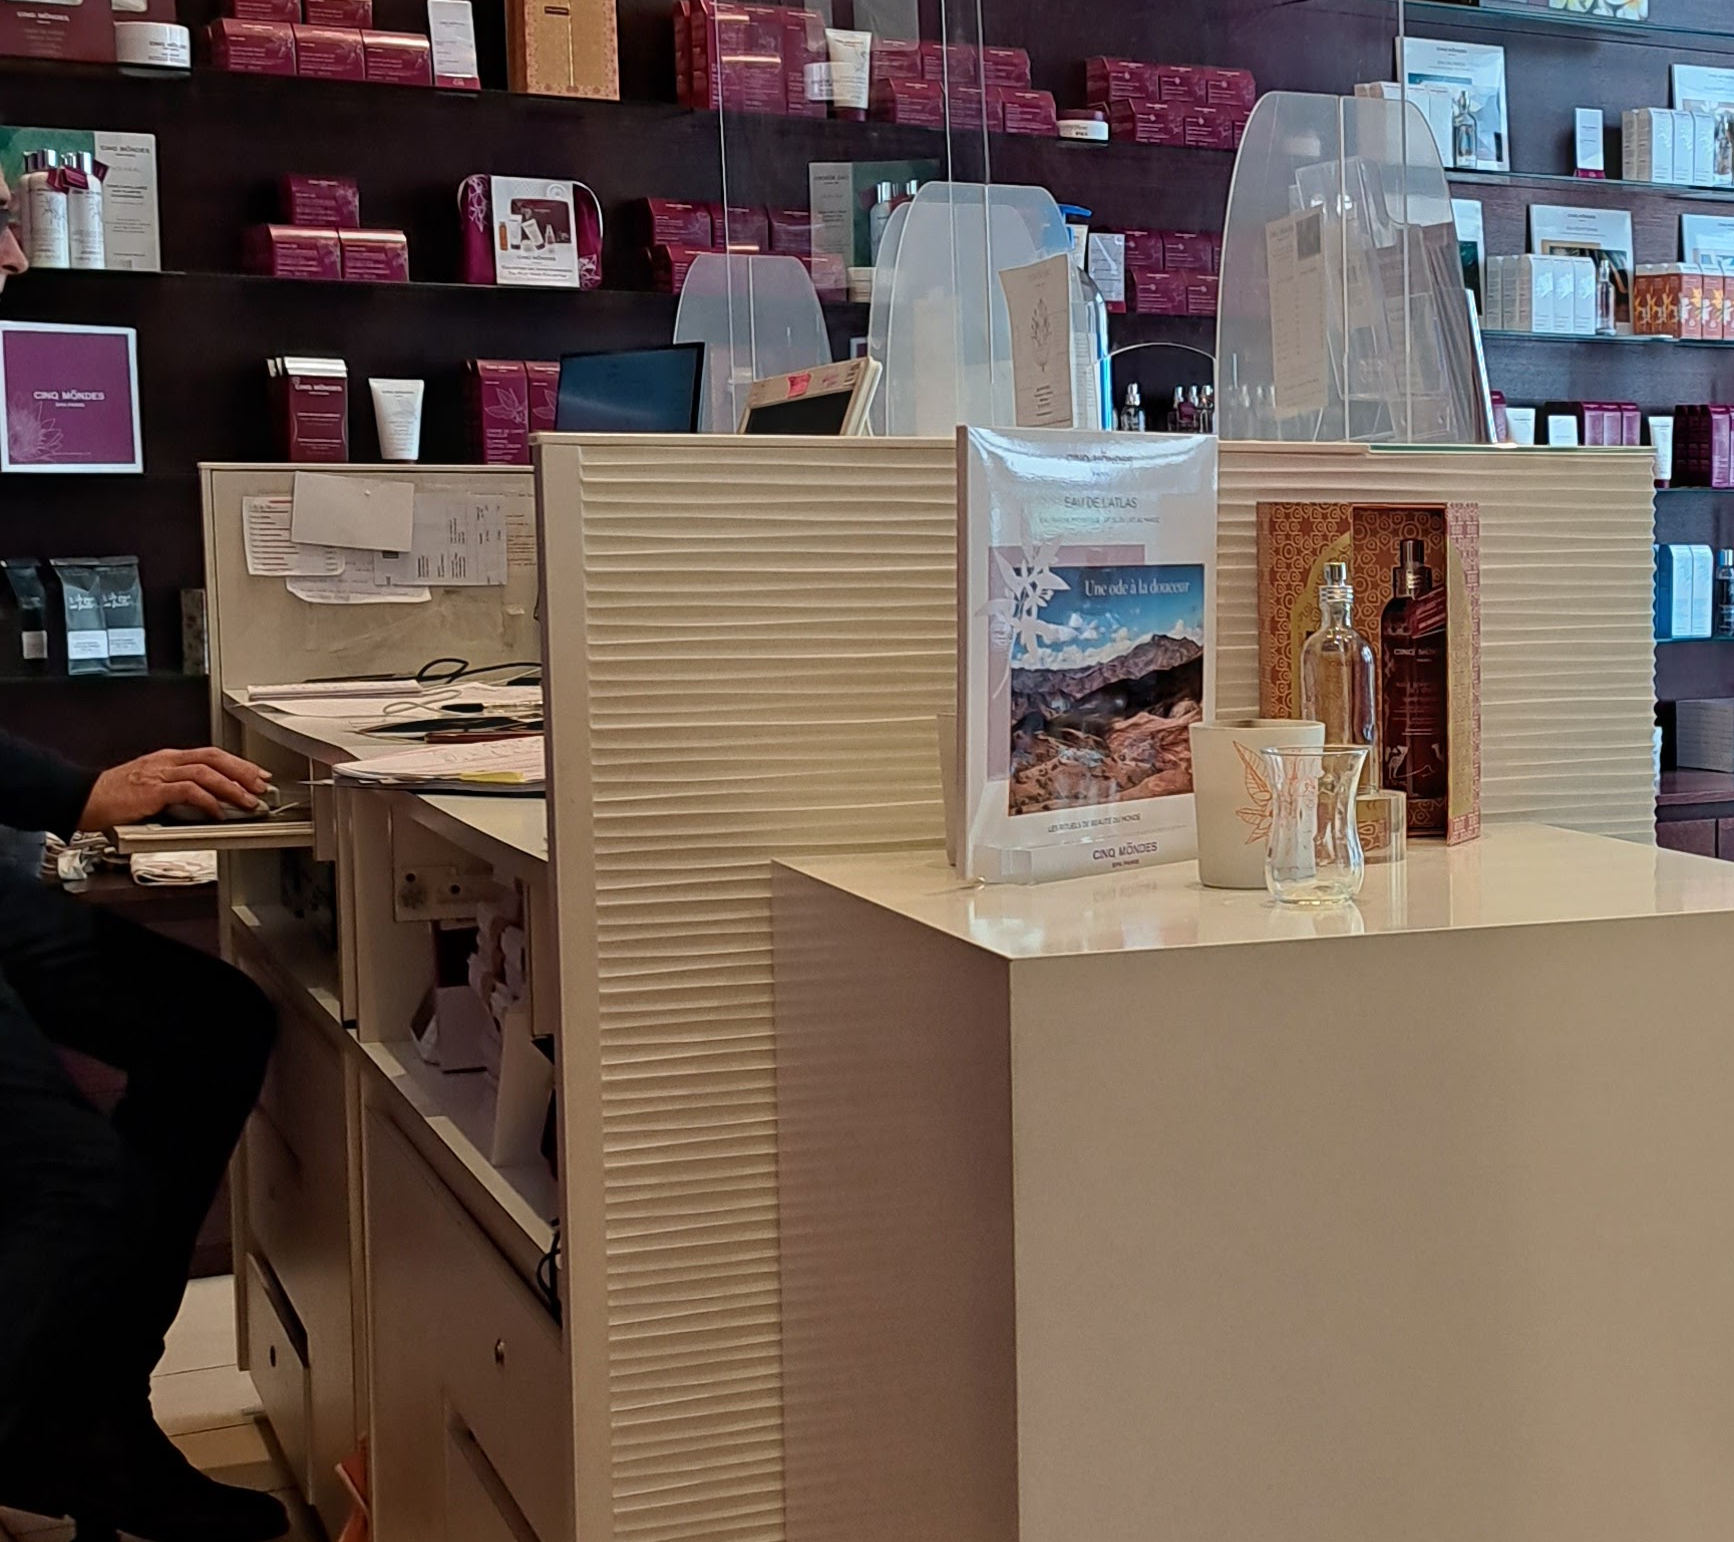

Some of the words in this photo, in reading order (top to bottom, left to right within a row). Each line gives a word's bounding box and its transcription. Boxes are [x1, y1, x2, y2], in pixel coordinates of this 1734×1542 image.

[1064, 496, 1085, 509] EAU
[1086, 496, 1101, 509] DE
[1084, 579, 1107, 597] Une
[1108, 578, 1128, 596] ode
[1129, 578, 1137, 595] à
[1138, 578, 1148, 594] la
[1149, 578, 1190, 594] douceur
[1092, 848, 1116, 860] CINQ
